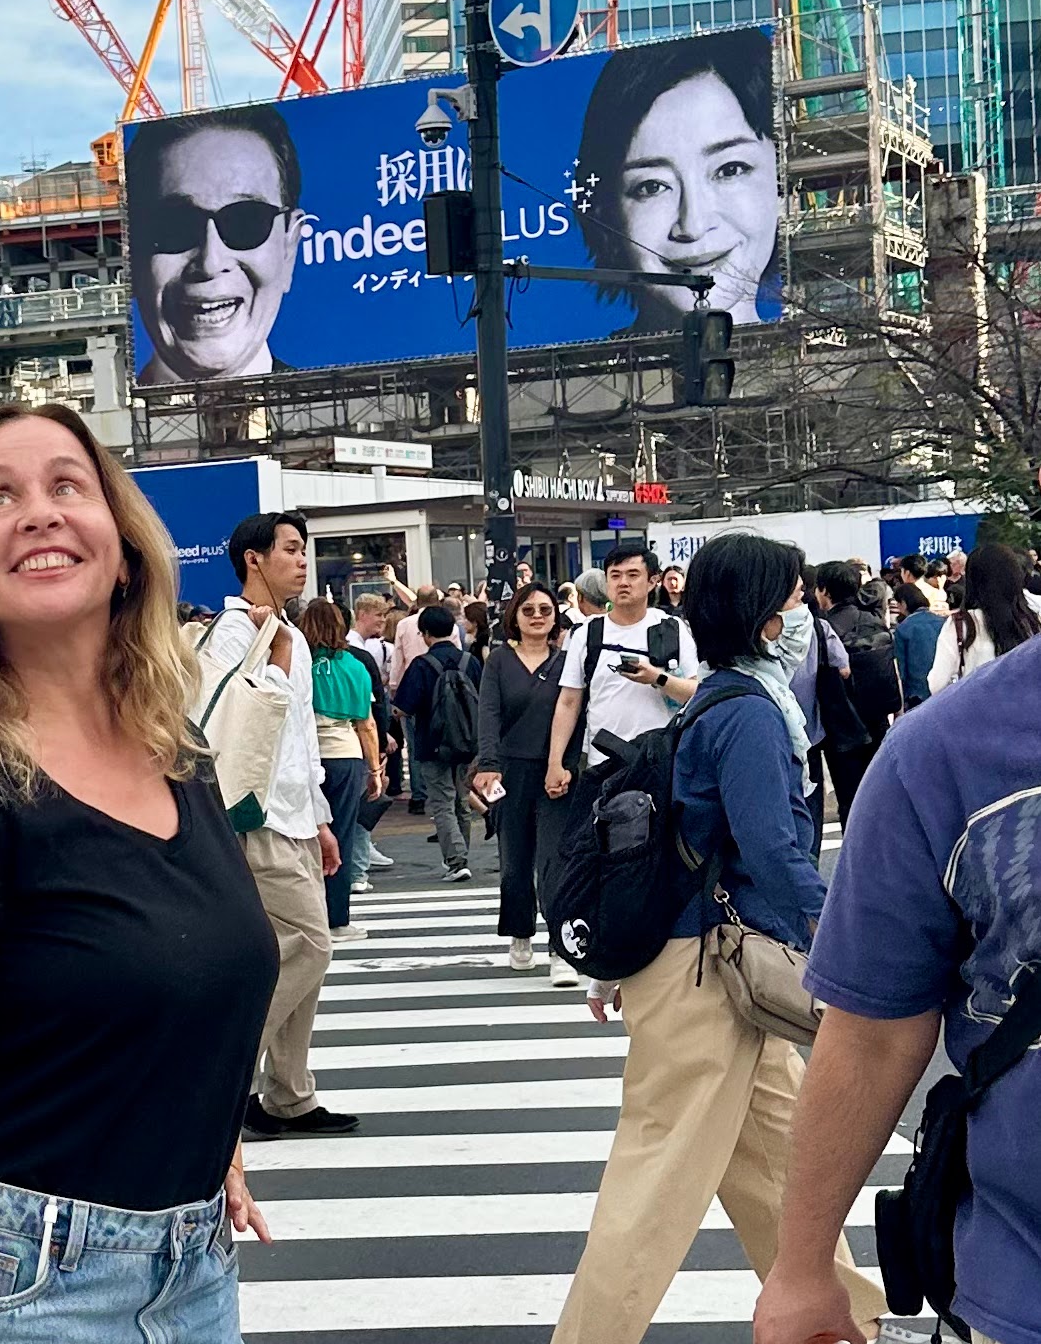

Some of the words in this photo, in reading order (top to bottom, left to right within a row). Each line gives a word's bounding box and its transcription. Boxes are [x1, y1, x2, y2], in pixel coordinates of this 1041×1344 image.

[302, 215, 427, 265] indee
[501, 203, 570, 241] LUS
[524, 474, 549, 499] SHIBU
[550, 476, 577, 501] HACHI
[578, 478, 596, 502] BOX
